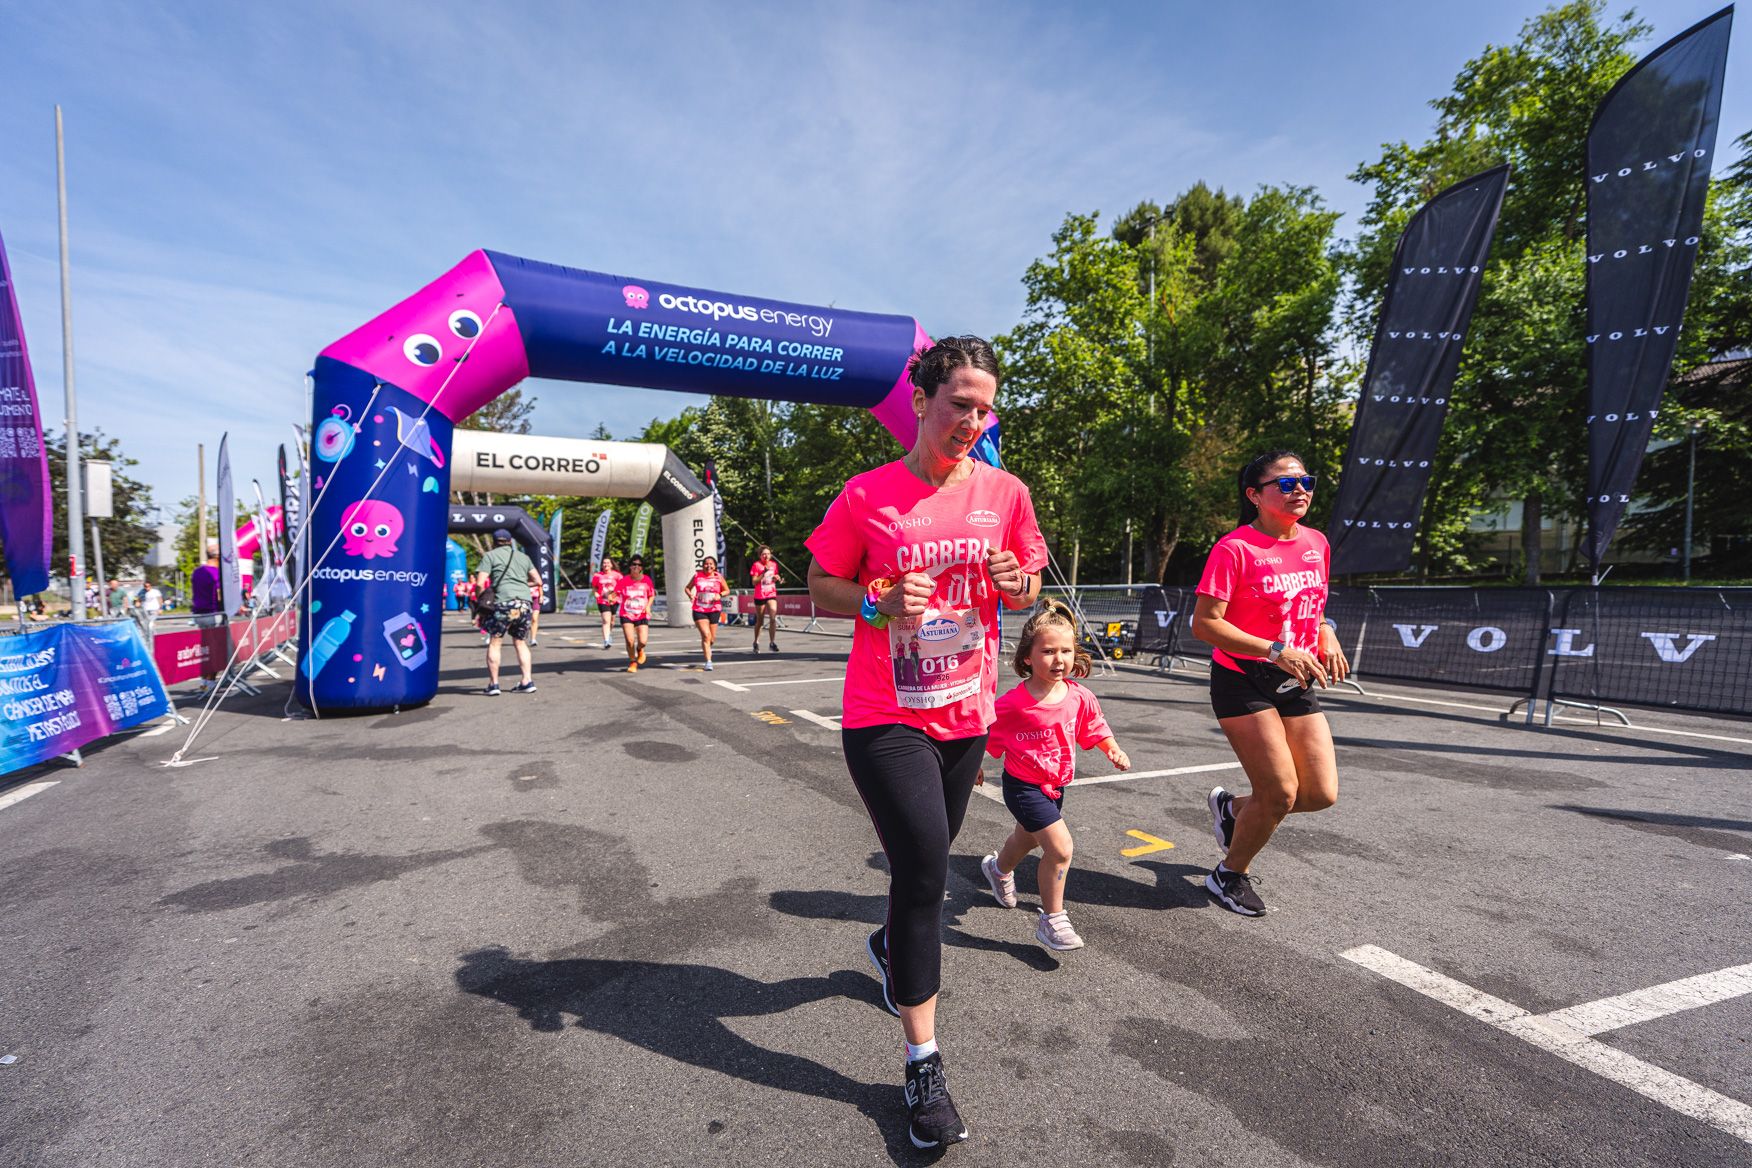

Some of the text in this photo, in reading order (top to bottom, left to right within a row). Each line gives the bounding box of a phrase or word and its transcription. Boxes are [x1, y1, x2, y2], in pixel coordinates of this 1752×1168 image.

[1591, 149, 1706, 183] VOLVO
[1588, 236, 1700, 264] VOLVO
[1402, 265, 1480, 275] VOLVO
[607, 318, 843, 362] LA ENERGÍA PARA CORRER
[1389, 331, 1462, 342] VOLVO
[1586, 324, 1683, 344] VOLV
[601, 341, 844, 380] A LA VELOCIDAD DE LA LUZ
[1374, 395, 1445, 405] VOLVO
[476, 452, 600, 474] EL CORREO
[1358, 457, 1429, 468] VOLVO
[663, 470, 693, 500] EL CORREO
[453, 514, 506, 523] LVO
[693, 519, 703, 536] EL
[888, 516, 932, 532] OYSHO
[1343, 519, 1412, 530] VOLVO
[594, 515, 608, 561] AMUTIO
[694, 538, 705, 569] COR
[897, 537, 990, 572] CARRERA
[1254, 556, 1282, 566] OYSHO
[540, 545, 550, 605] VOLVO
[1262, 569, 1323, 594] CARRERA
[920, 627, 958, 638] ASTURIANA
[922, 655, 959, 674] 016
[905, 695, 935, 704] OYSHO
[1016, 728, 1053, 741] OYSHO
